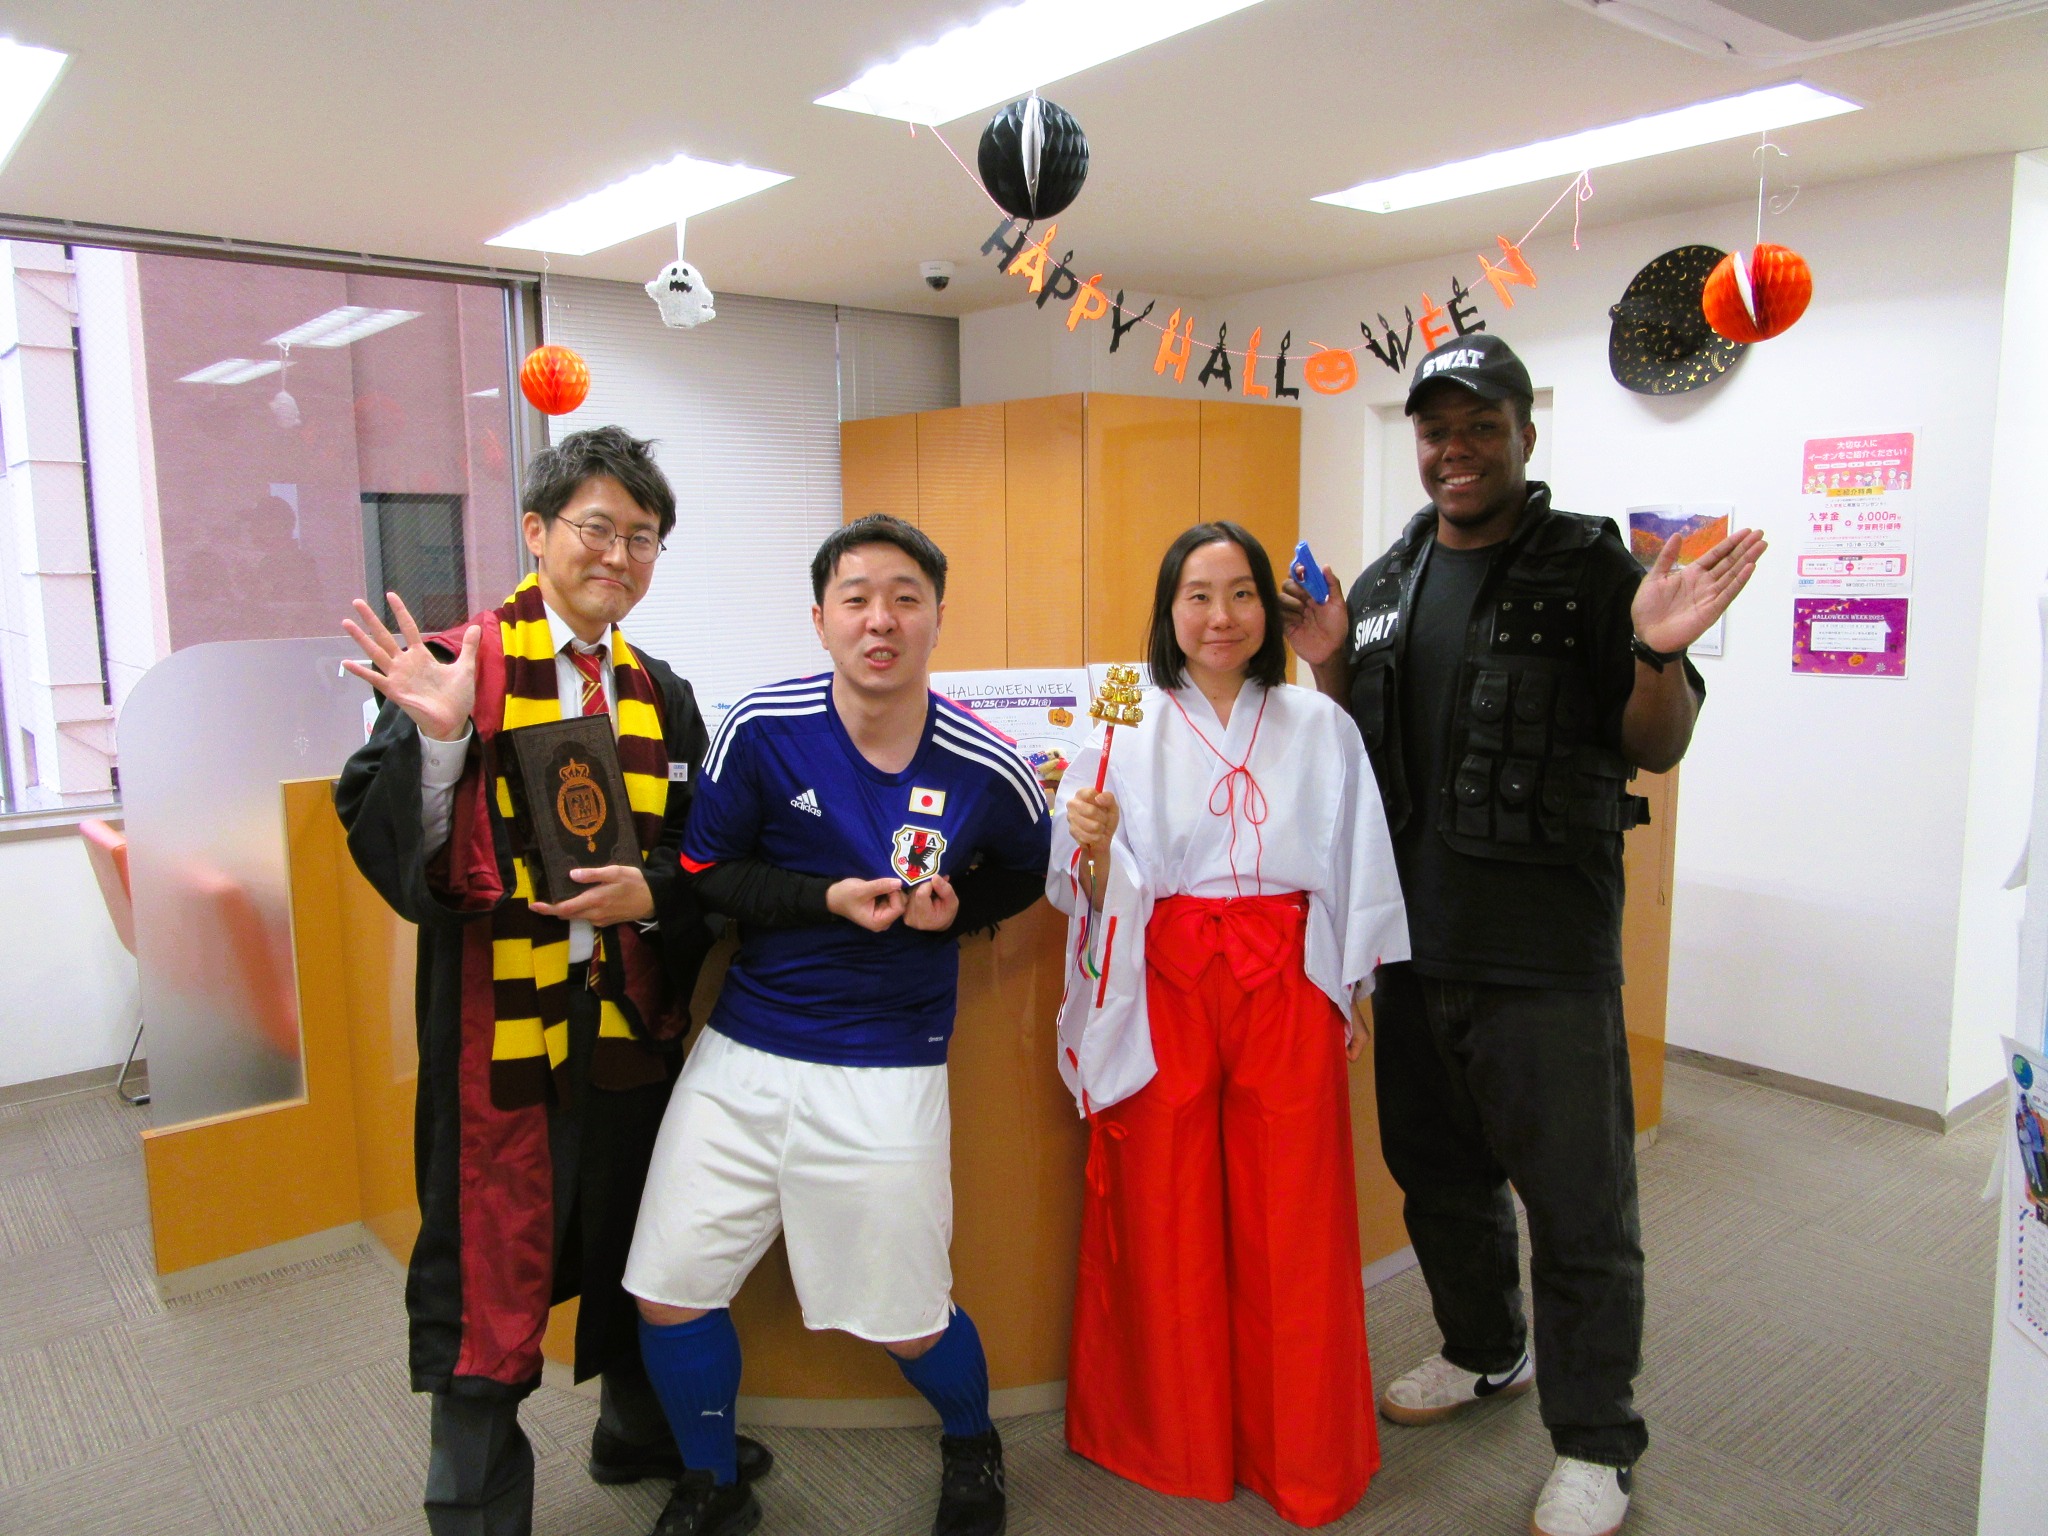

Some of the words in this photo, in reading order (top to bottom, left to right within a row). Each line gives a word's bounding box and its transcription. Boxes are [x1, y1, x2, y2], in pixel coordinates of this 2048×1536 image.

[980, 217, 1155, 354] HAPPY
[1422, 348, 1485, 379] SWAT
[1836, 439, 1879, 450] 大切な人に
[1808, 512, 1840, 522] 入学金
[1813, 524, 1834, 533] 無料
[1354, 611, 1399, 652] SWAT
[946, 683, 1034, 699] HALLOWEEN
[1037, 682, 1074, 696] WEEK
[790, 799, 822, 817] adidas
[903, 832, 937, 847] JFA
